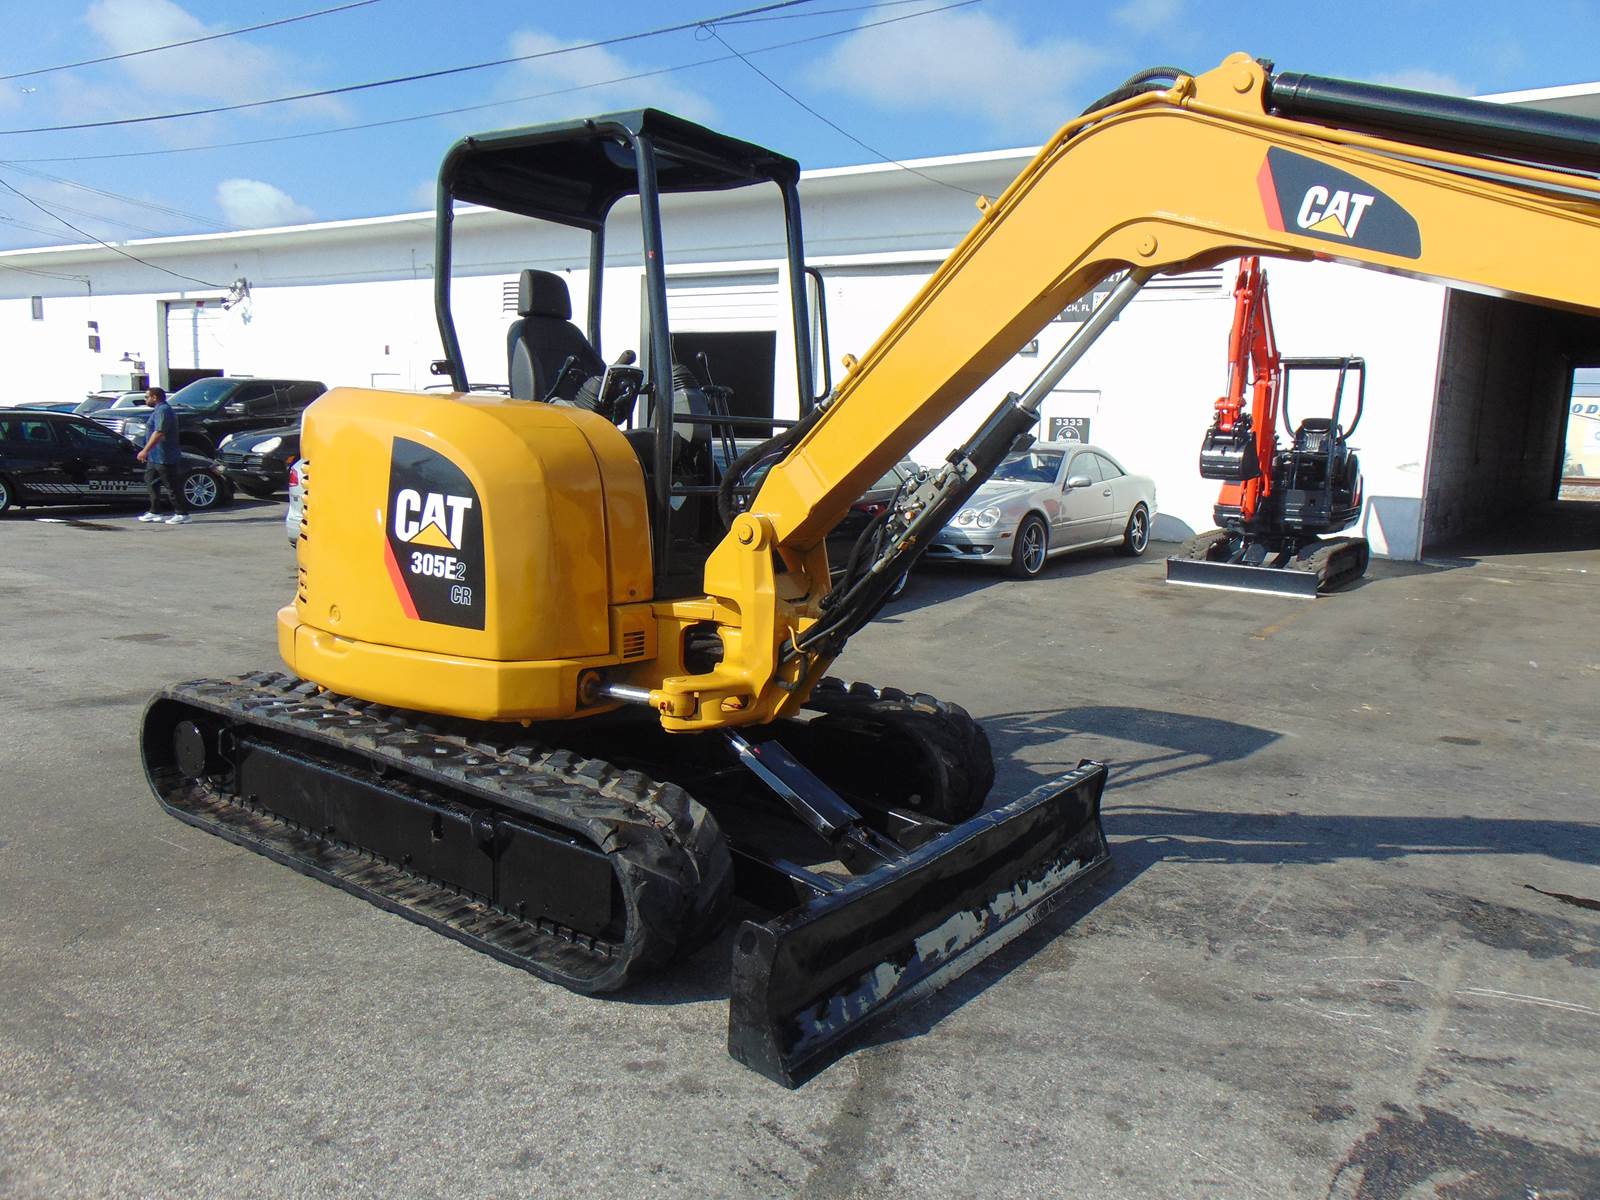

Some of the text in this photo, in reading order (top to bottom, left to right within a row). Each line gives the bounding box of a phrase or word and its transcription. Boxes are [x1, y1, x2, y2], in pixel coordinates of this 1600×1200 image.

[1297, 185, 1375, 239] CAT
[1081, 304, 1090, 312] FL
[1055, 418, 1083, 426] 3333
[88, 480, 129, 491] BMW
[395, 488, 473, 550] CAT
[411, 551, 467, 581] 305E2
[450, 585, 472, 605] CR
